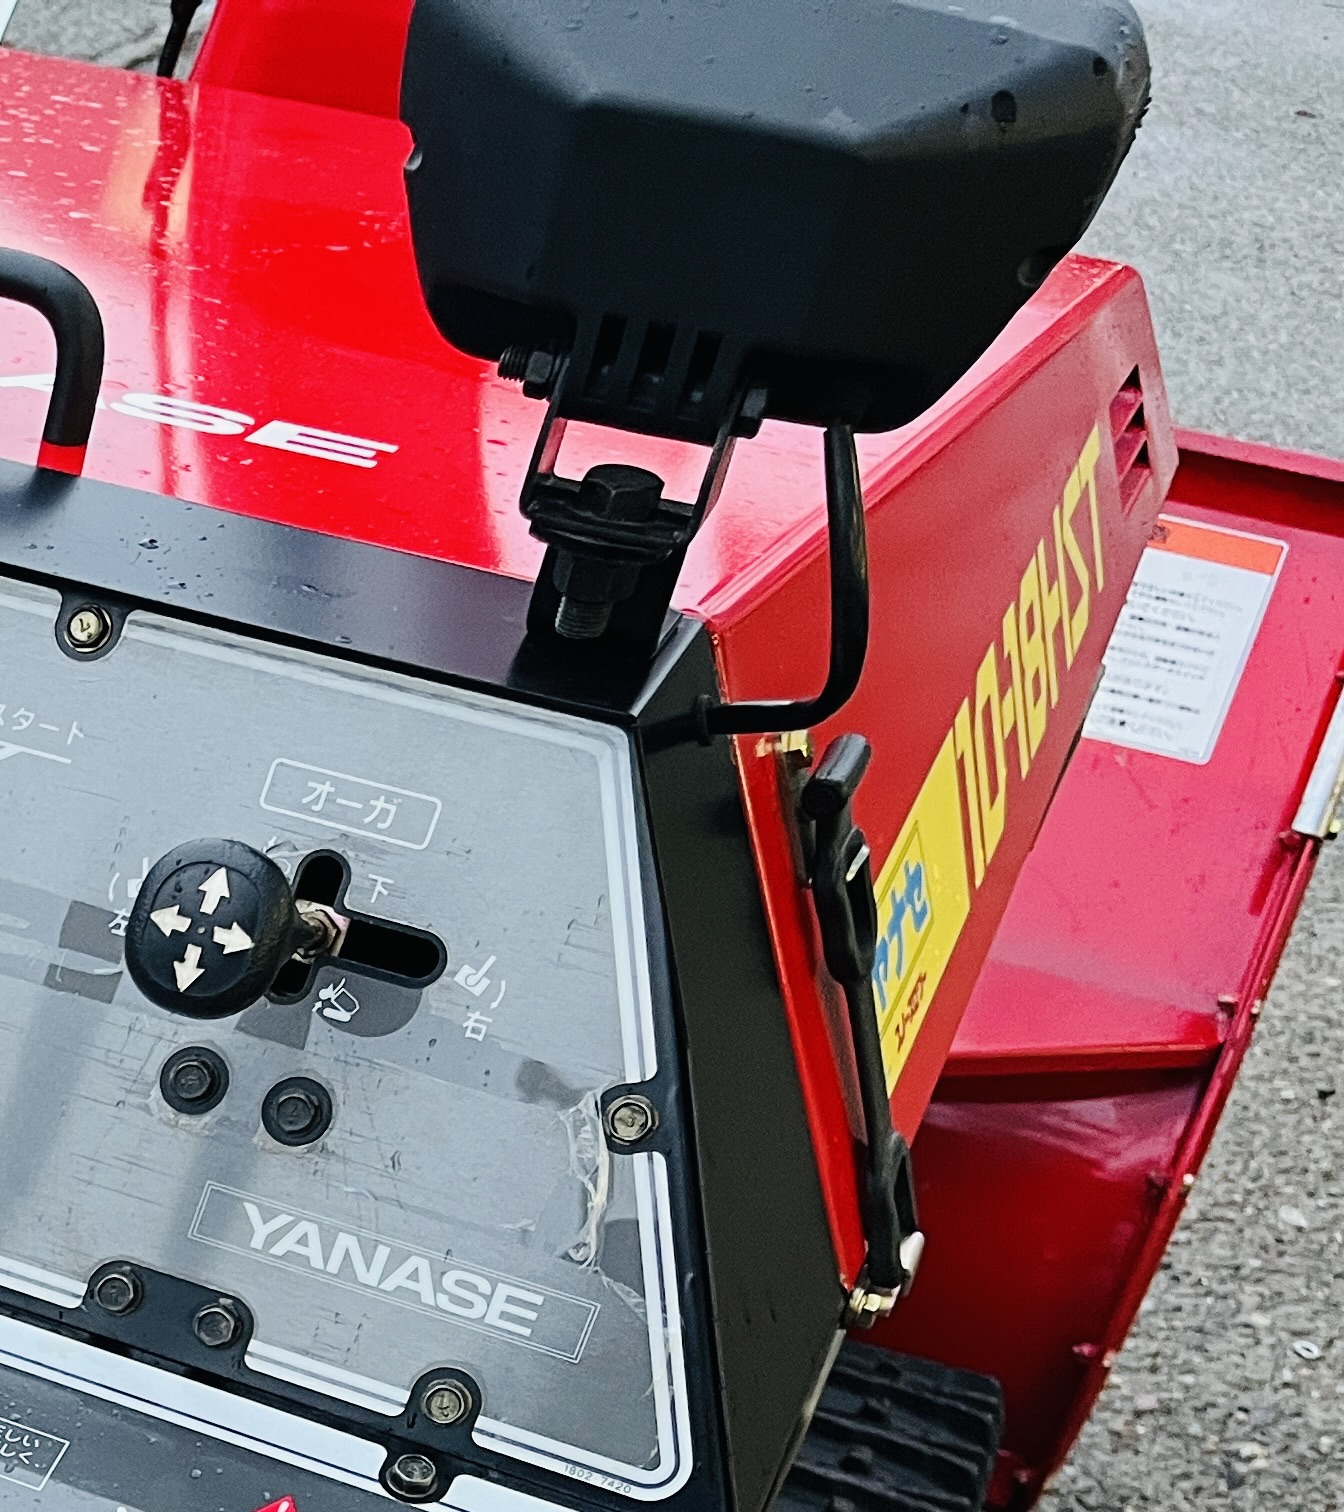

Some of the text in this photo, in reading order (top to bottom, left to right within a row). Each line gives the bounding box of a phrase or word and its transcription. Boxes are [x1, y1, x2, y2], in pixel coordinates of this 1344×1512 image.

[301, 780, 403, 829] オーガ
[367, 874, 395, 903] 下
[462, 1010, 493, 1041] 右
[242, 1201, 545, 1338] YANASE
[564, 1464, 632, 1494] 1802 7420
